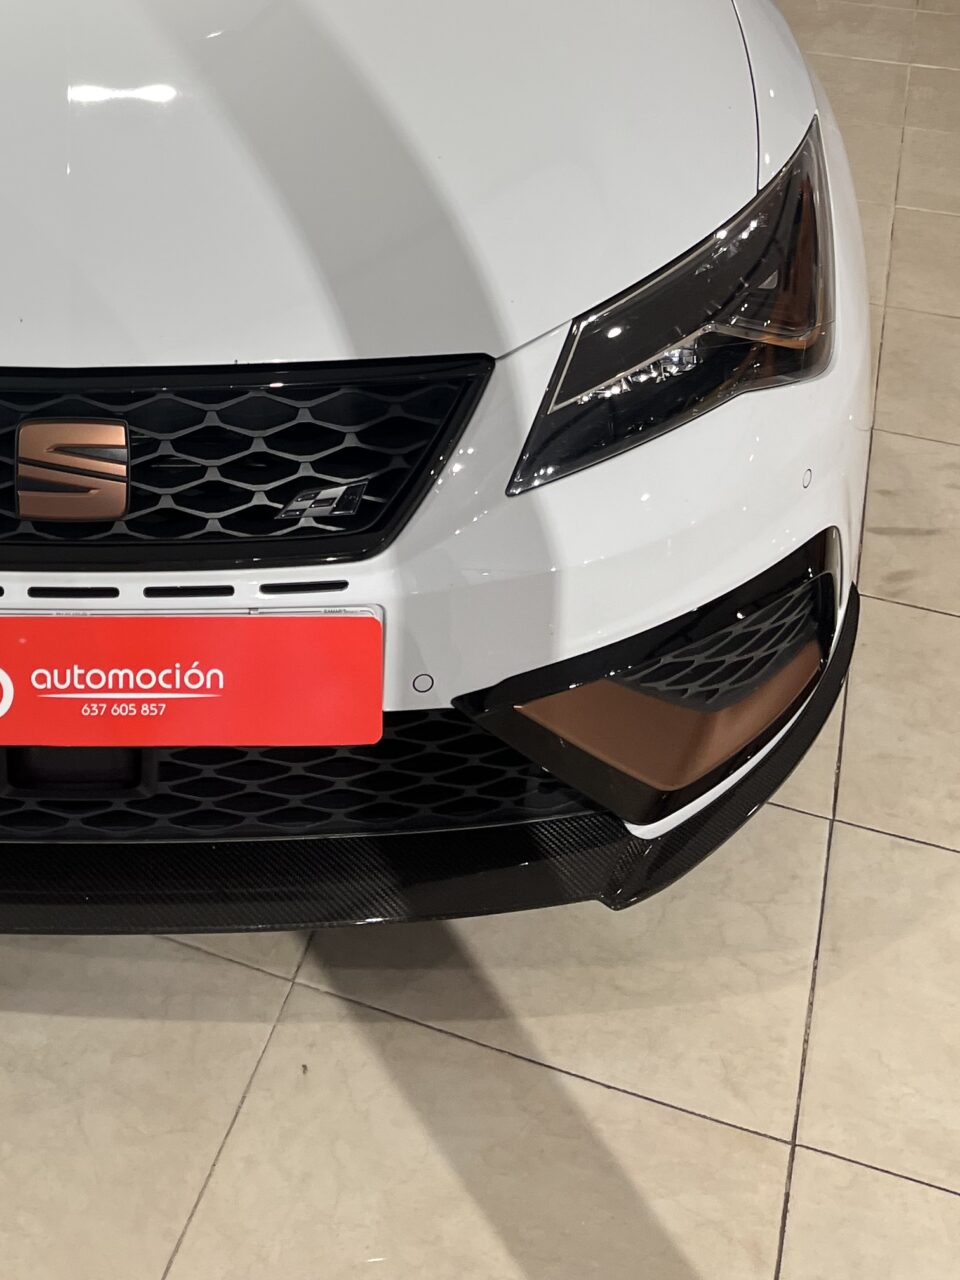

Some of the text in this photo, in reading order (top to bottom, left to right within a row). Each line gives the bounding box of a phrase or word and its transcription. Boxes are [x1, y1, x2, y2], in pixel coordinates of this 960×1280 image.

[30, 661, 224, 690] automoción
[81, 703, 166, 716] 637 605 857
